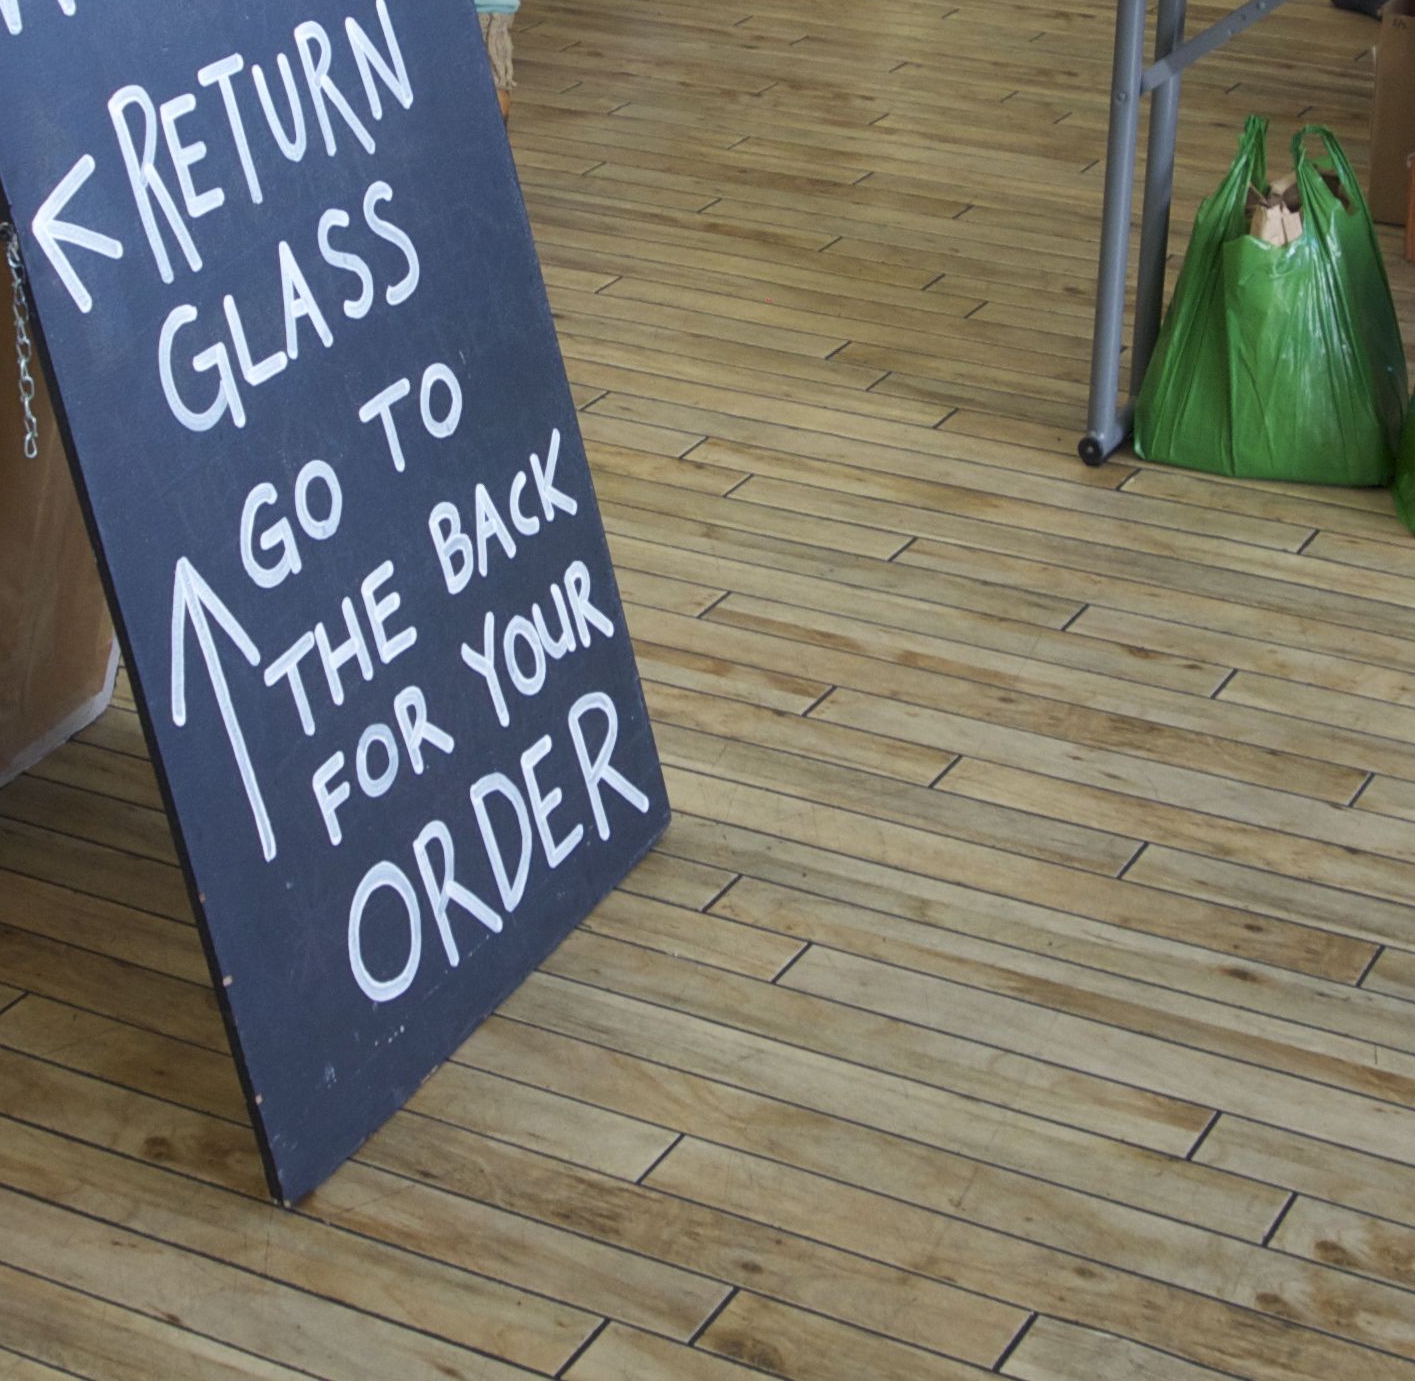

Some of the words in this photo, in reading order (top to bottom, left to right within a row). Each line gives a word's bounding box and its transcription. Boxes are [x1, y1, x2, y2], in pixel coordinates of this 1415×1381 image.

[157, 180, 421, 433] GLASS
[239, 460, 343, 589] GO
[359, 362, 463, 473] TO
[263, 559, 418, 736] THE
[428, 427, 579, 595] BACK
[311, 685, 456, 846] FOR
[460, 560, 615, 728] YOUR
[347, 690, 651, 1003] ORDER
